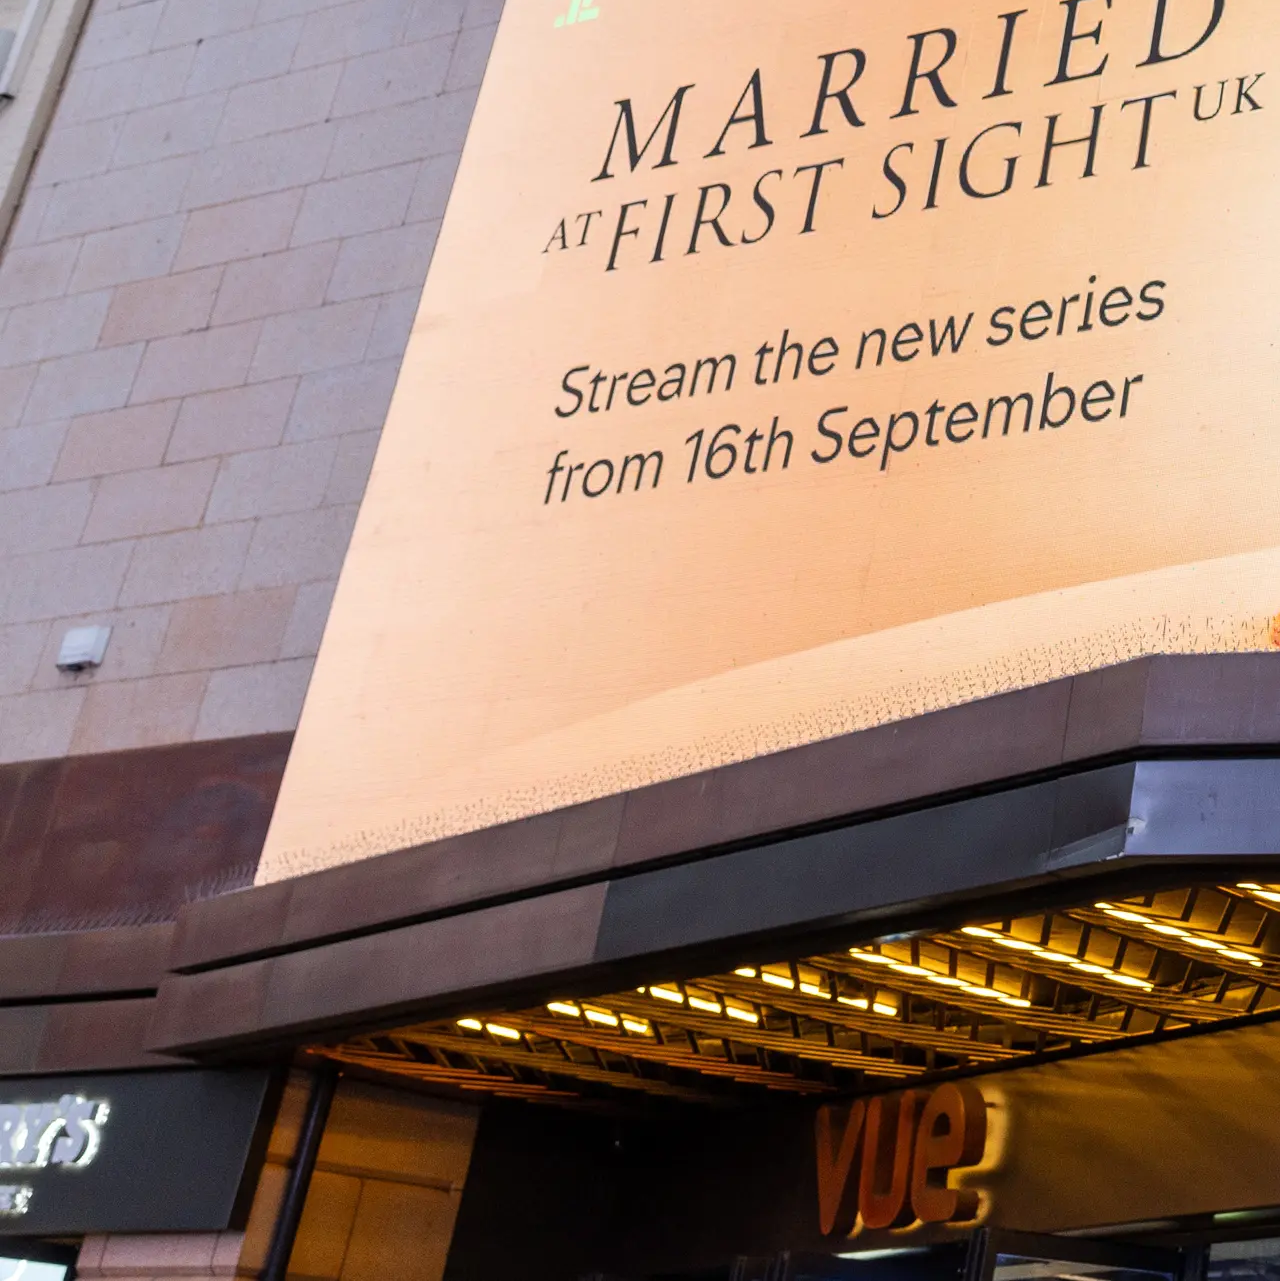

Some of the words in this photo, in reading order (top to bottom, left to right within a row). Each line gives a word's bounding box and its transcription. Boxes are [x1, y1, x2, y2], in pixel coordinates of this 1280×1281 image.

[541, 209, 603, 255] AT
[603, 157, 846, 273] FIRST
[871, 89, 1178, 221] SIGHT
[1192, 72, 1266, 125] UK
[554, 354, 737, 419] Stream
[754, 328, 840, 386] the
[855, 311, 975, 371] new
[986, 275, 1166, 348] series
[543, 448, 664, 506] from
[684, 415, 794, 484] 16th
[810, 370, 1145, 473] September
